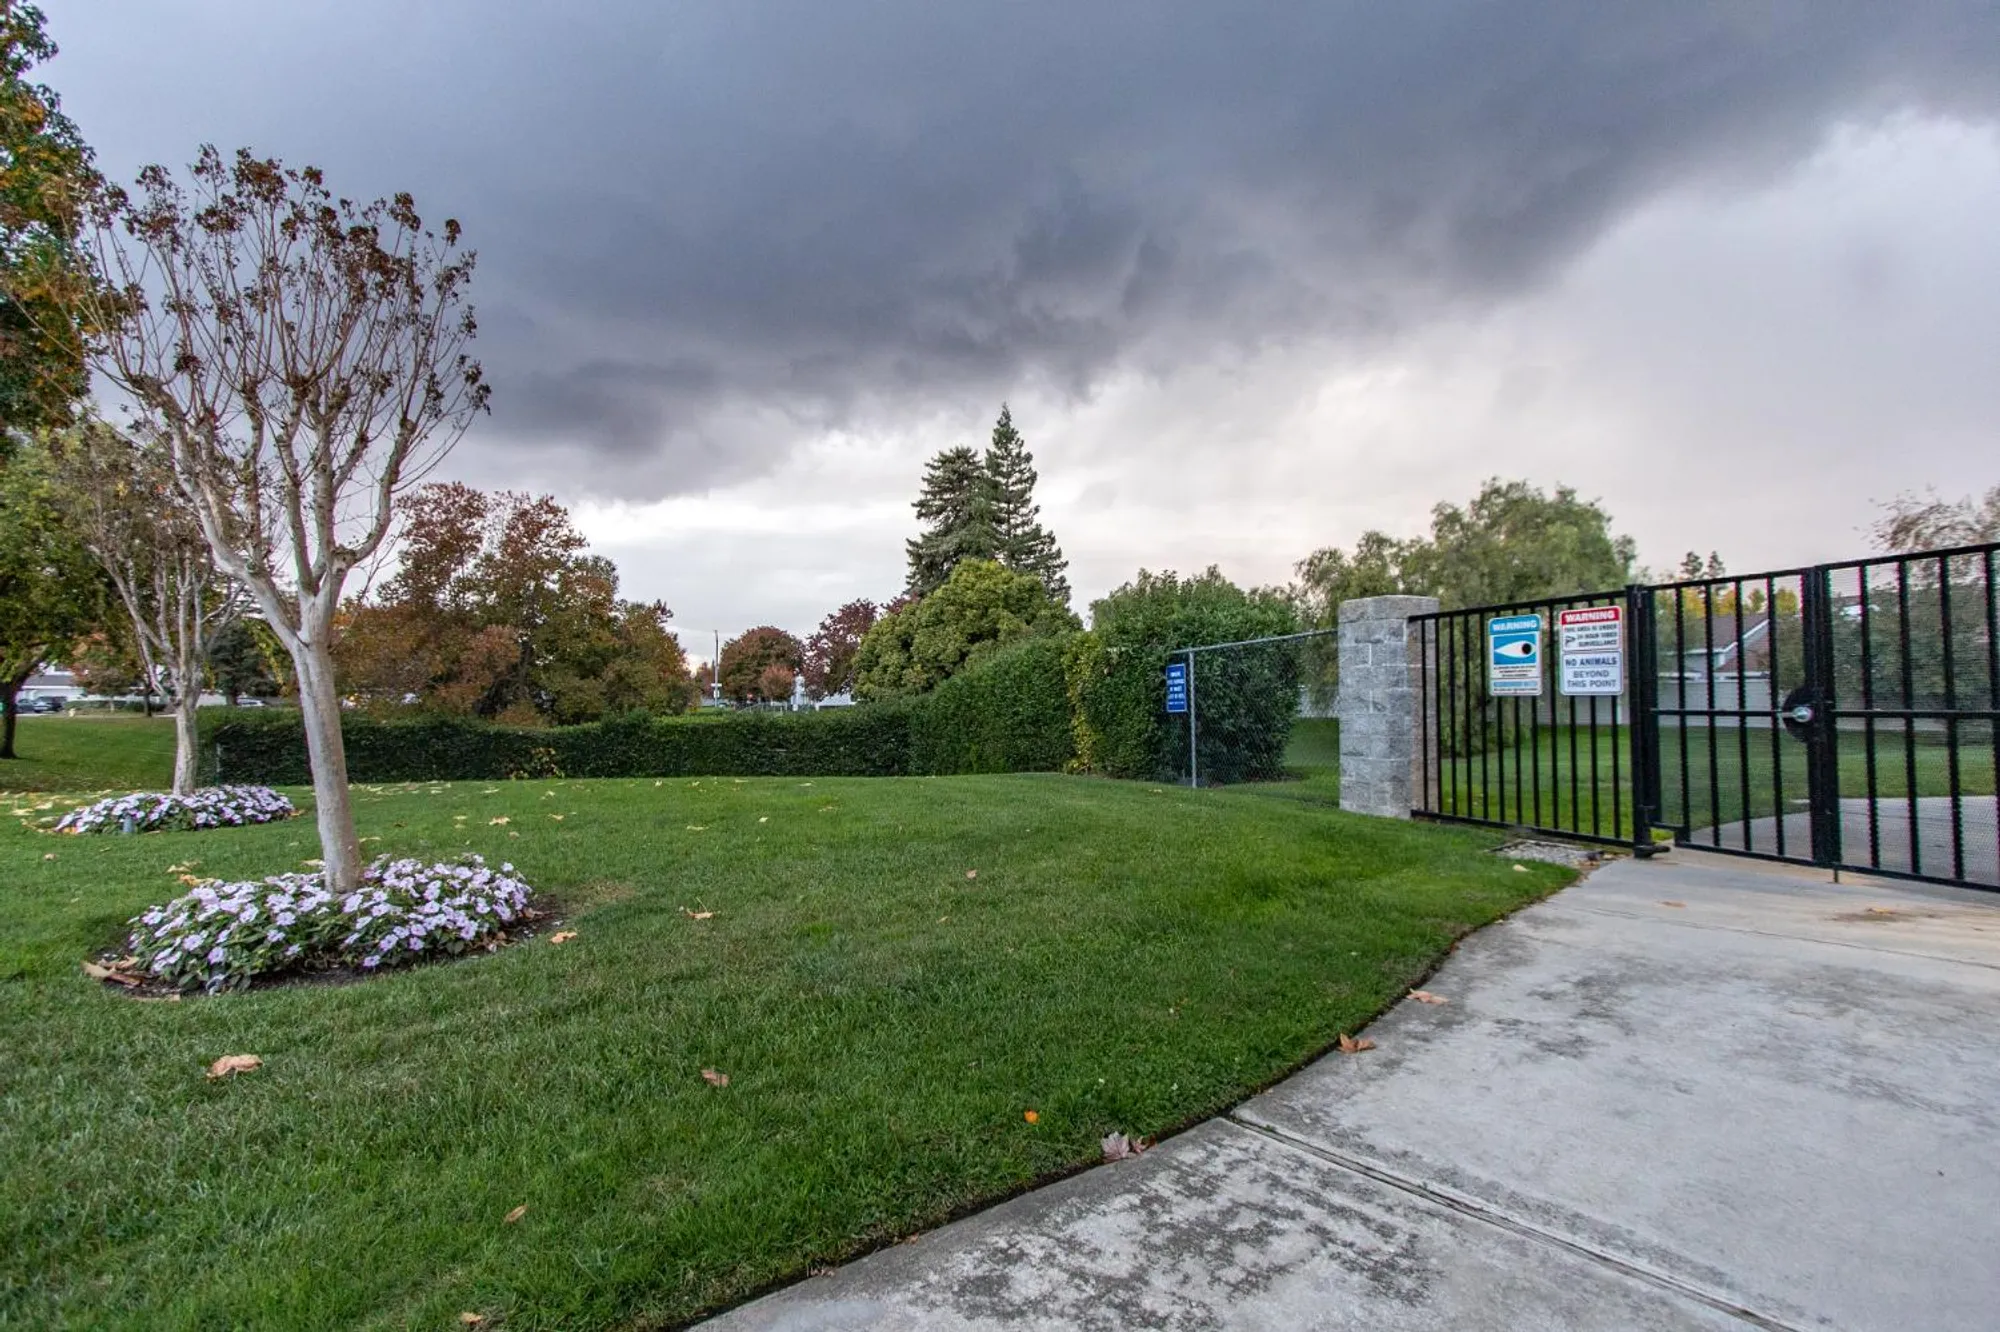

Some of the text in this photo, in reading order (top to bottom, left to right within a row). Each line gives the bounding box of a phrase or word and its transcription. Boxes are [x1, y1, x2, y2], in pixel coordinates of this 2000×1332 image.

[1565, 611, 1615, 622] WARNING
[1492, 620, 1537, 631] WARNING
[1579, 657, 1617, 666] ANIMALS
[1573, 670, 1609, 678] BEYOND
[1567, 679, 1617, 688] THIS POINT
